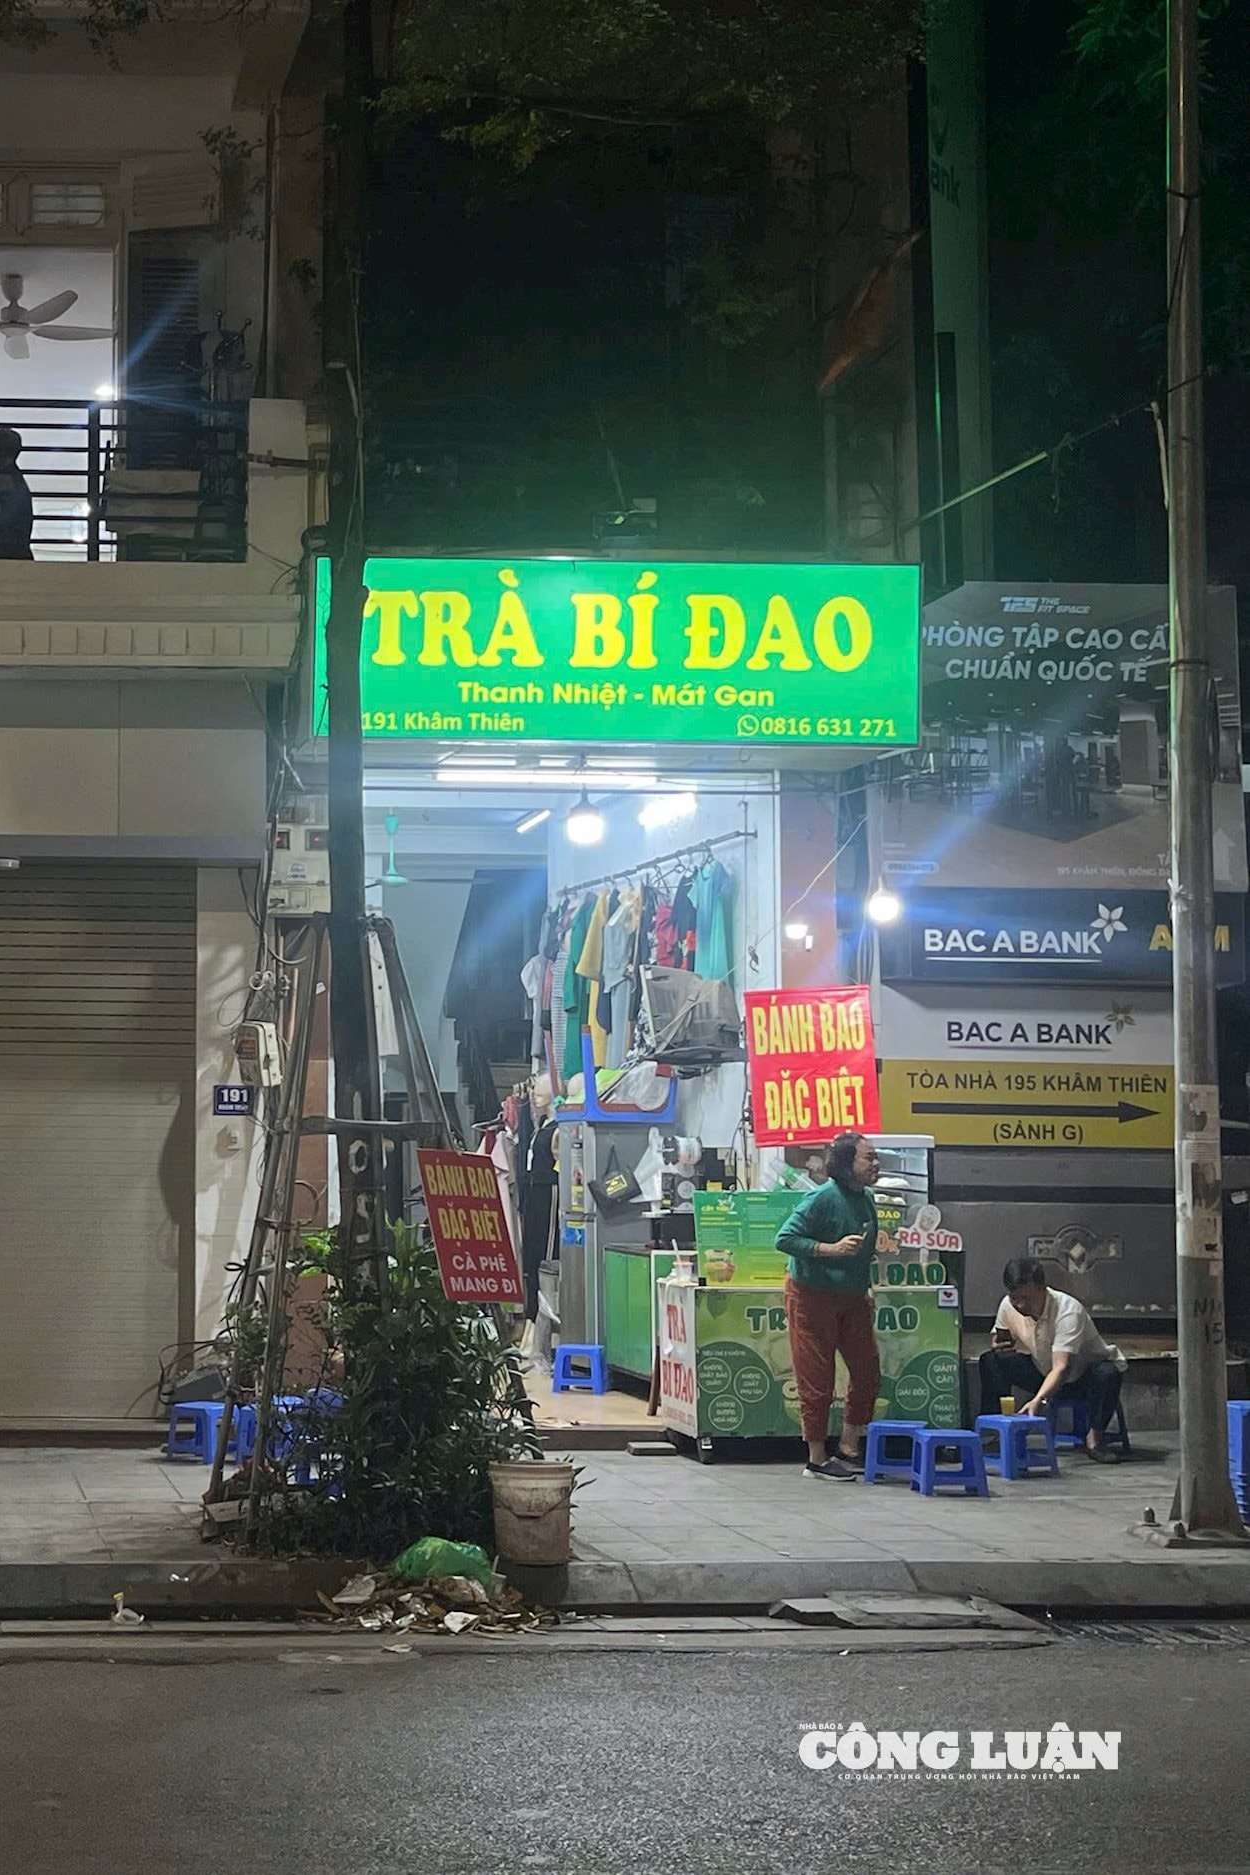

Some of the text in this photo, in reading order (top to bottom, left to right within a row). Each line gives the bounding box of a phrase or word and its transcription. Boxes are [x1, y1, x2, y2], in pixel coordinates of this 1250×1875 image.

[363, 569, 872, 672] TRÀ BÍ ĐAO
[922, 620, 1170, 654] HÒNG TẬP CAO CẤ
[945, 651, 1153, 685] CHUẨN QUỐC TẾ
[457, 681, 544, 704] Thanh
[553, 682, 628, 711] Nhiệt
[651, 682, 707, 706] Mát
[714, 684, 775, 707] Gan
[362, 711, 526, 732] 191 Khâm Thiên
[761, 716, 897, 737] 0816 631 271
[924, 929, 1102, 955] BAC A BANK
[1149, 924, 1231, 952] AM
[752, 995, 866, 1056] BÁNH BAO
[947, 1021, 1112, 1045] BAC A BANK
[907, 1070, 1168, 1093] TÒA NHÀ 195 KHÂM THIÊN
[221, 1089, 248, 1103] 191
[764, 1066, 865, 1141] ĐẶC BIỆT
[993, 1119, 1084, 1144] (SẢNH G)
[425, 1158, 498, 1199] BÁNH BAO
[438, 1203, 503, 1249] ĐẶC BIỆT
[927, 1230, 960, 1249] SỮA
[452, 1252, 508, 1273] CÀ PHÊ
[450, 1275, 518, 1294] MANG ĐI
[746, 1306, 919, 1332] TR AO
